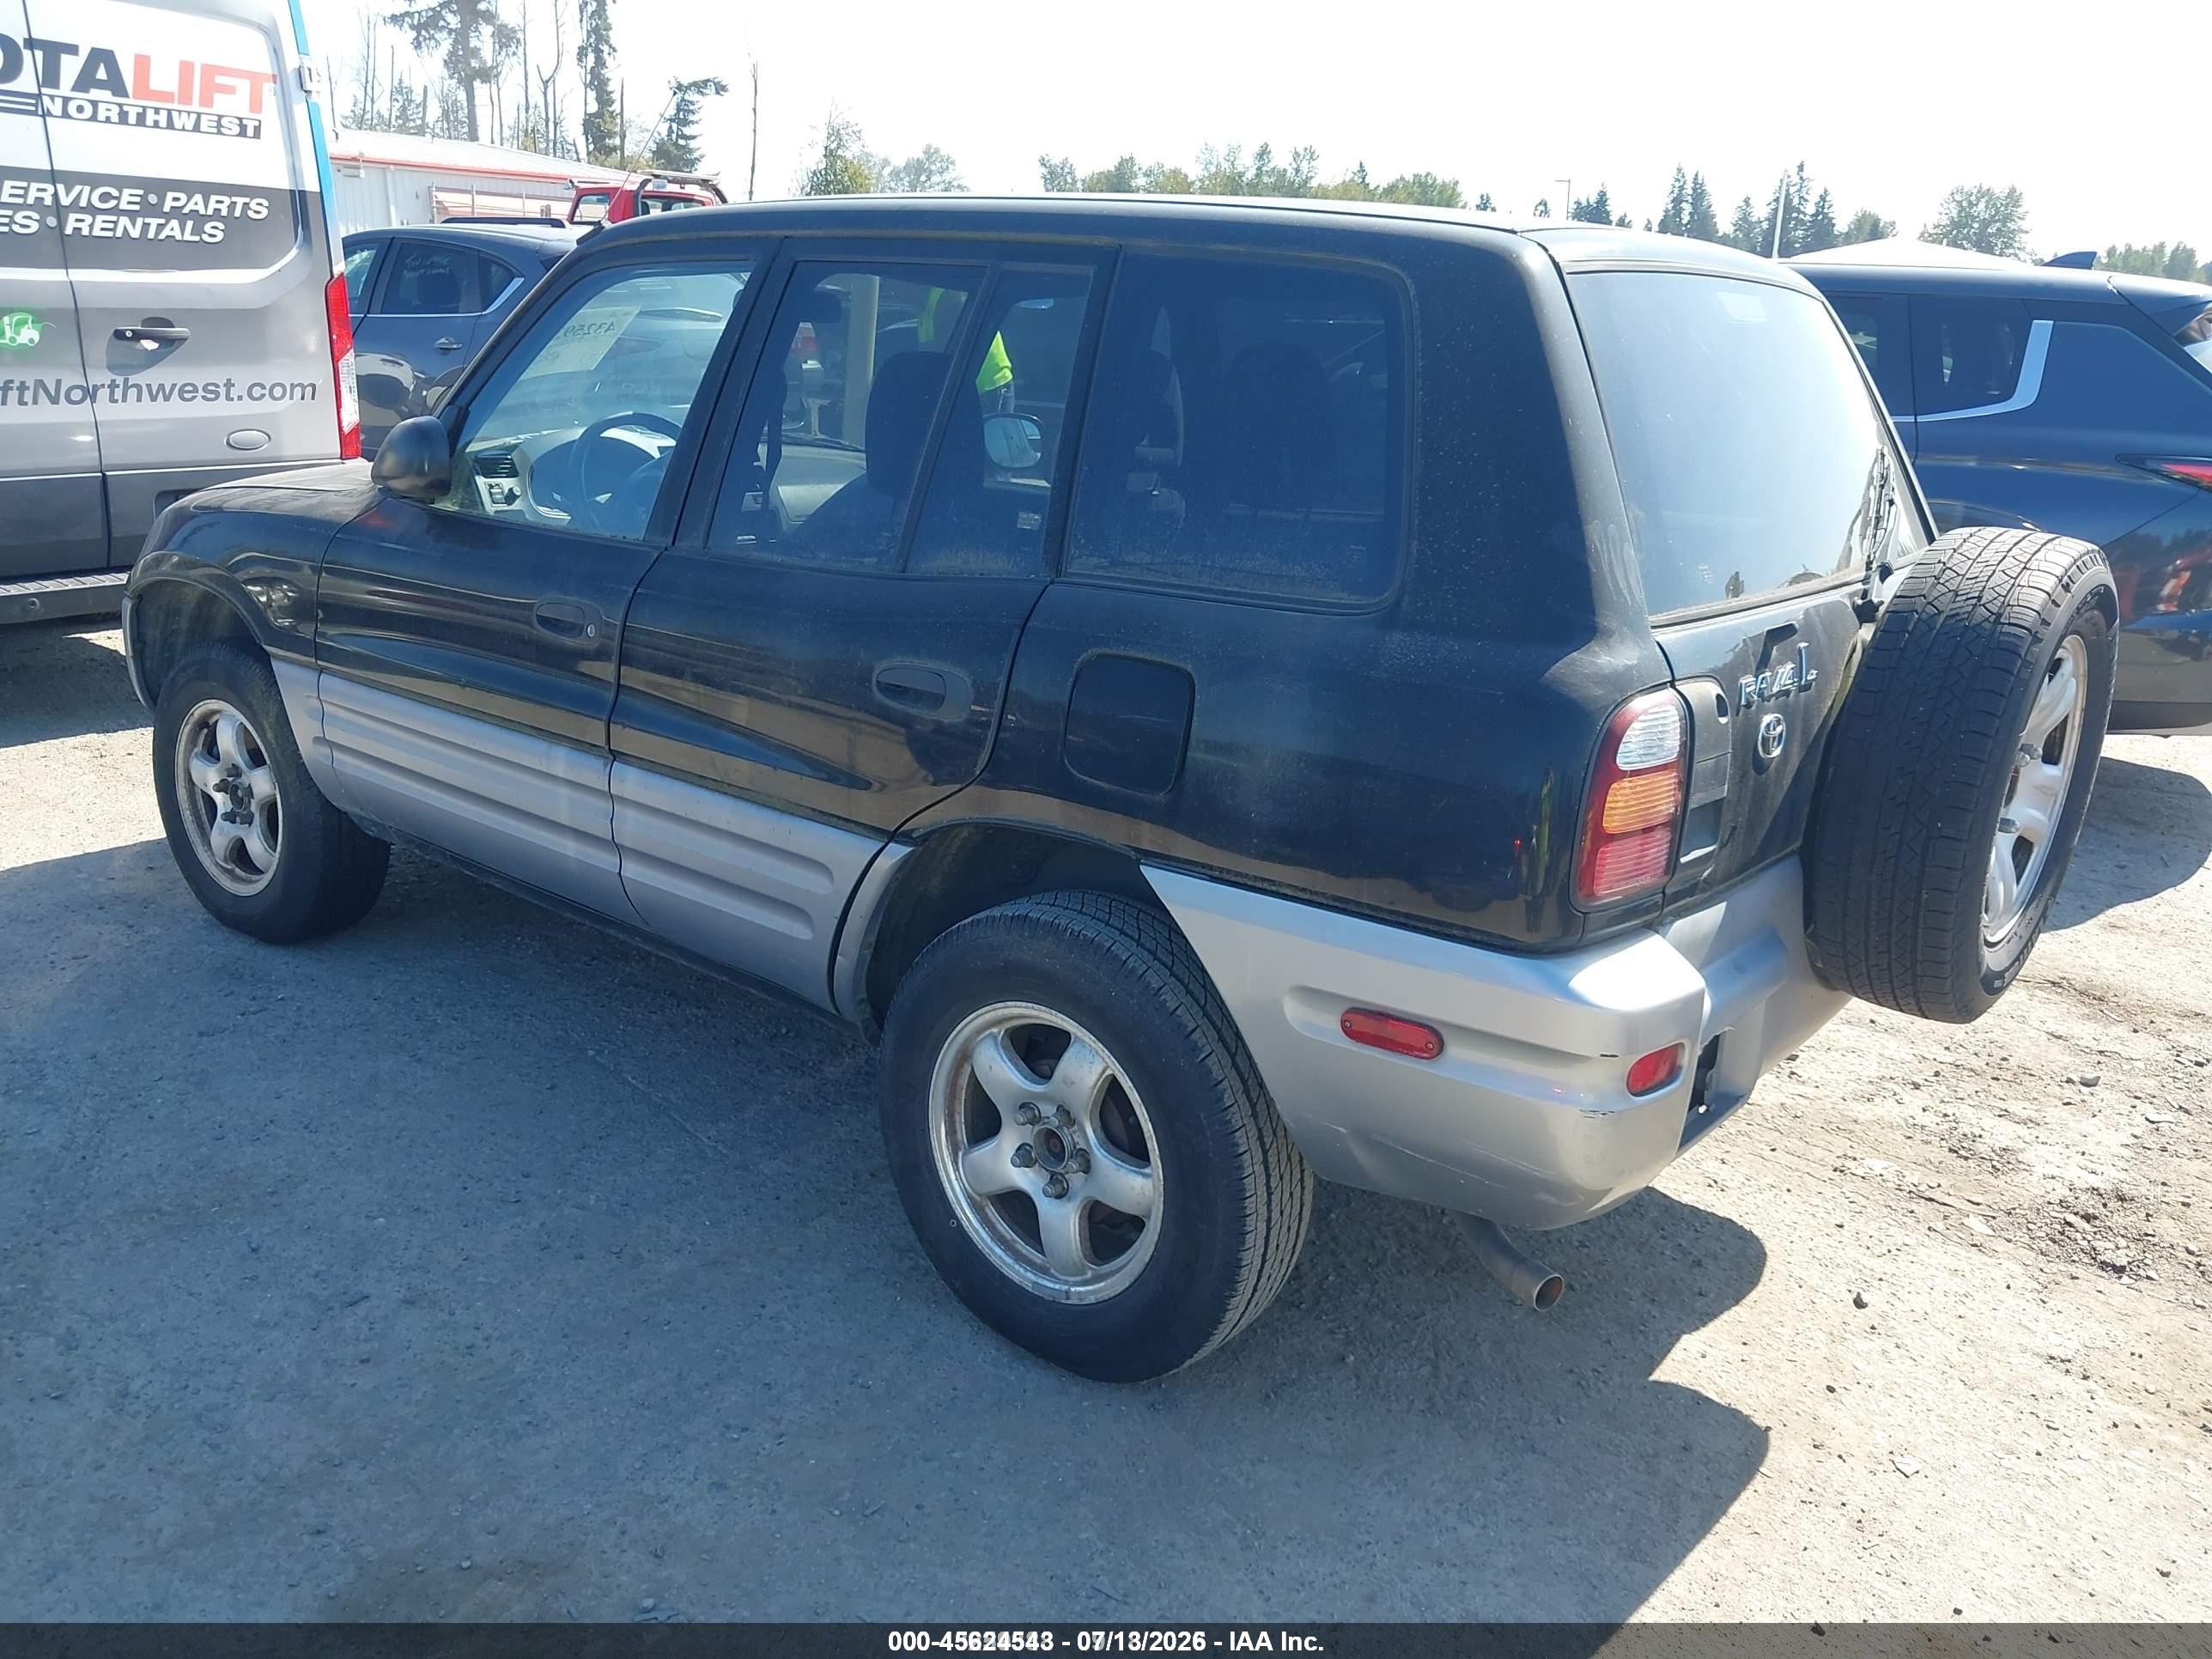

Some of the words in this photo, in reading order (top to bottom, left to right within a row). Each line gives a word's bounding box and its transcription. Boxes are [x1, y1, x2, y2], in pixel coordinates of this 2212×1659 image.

[38, 95, 261, 137] NORTHWEST
[162, 191, 270, 220] PARTS
[64, 213, 226, 244] RENTALS
